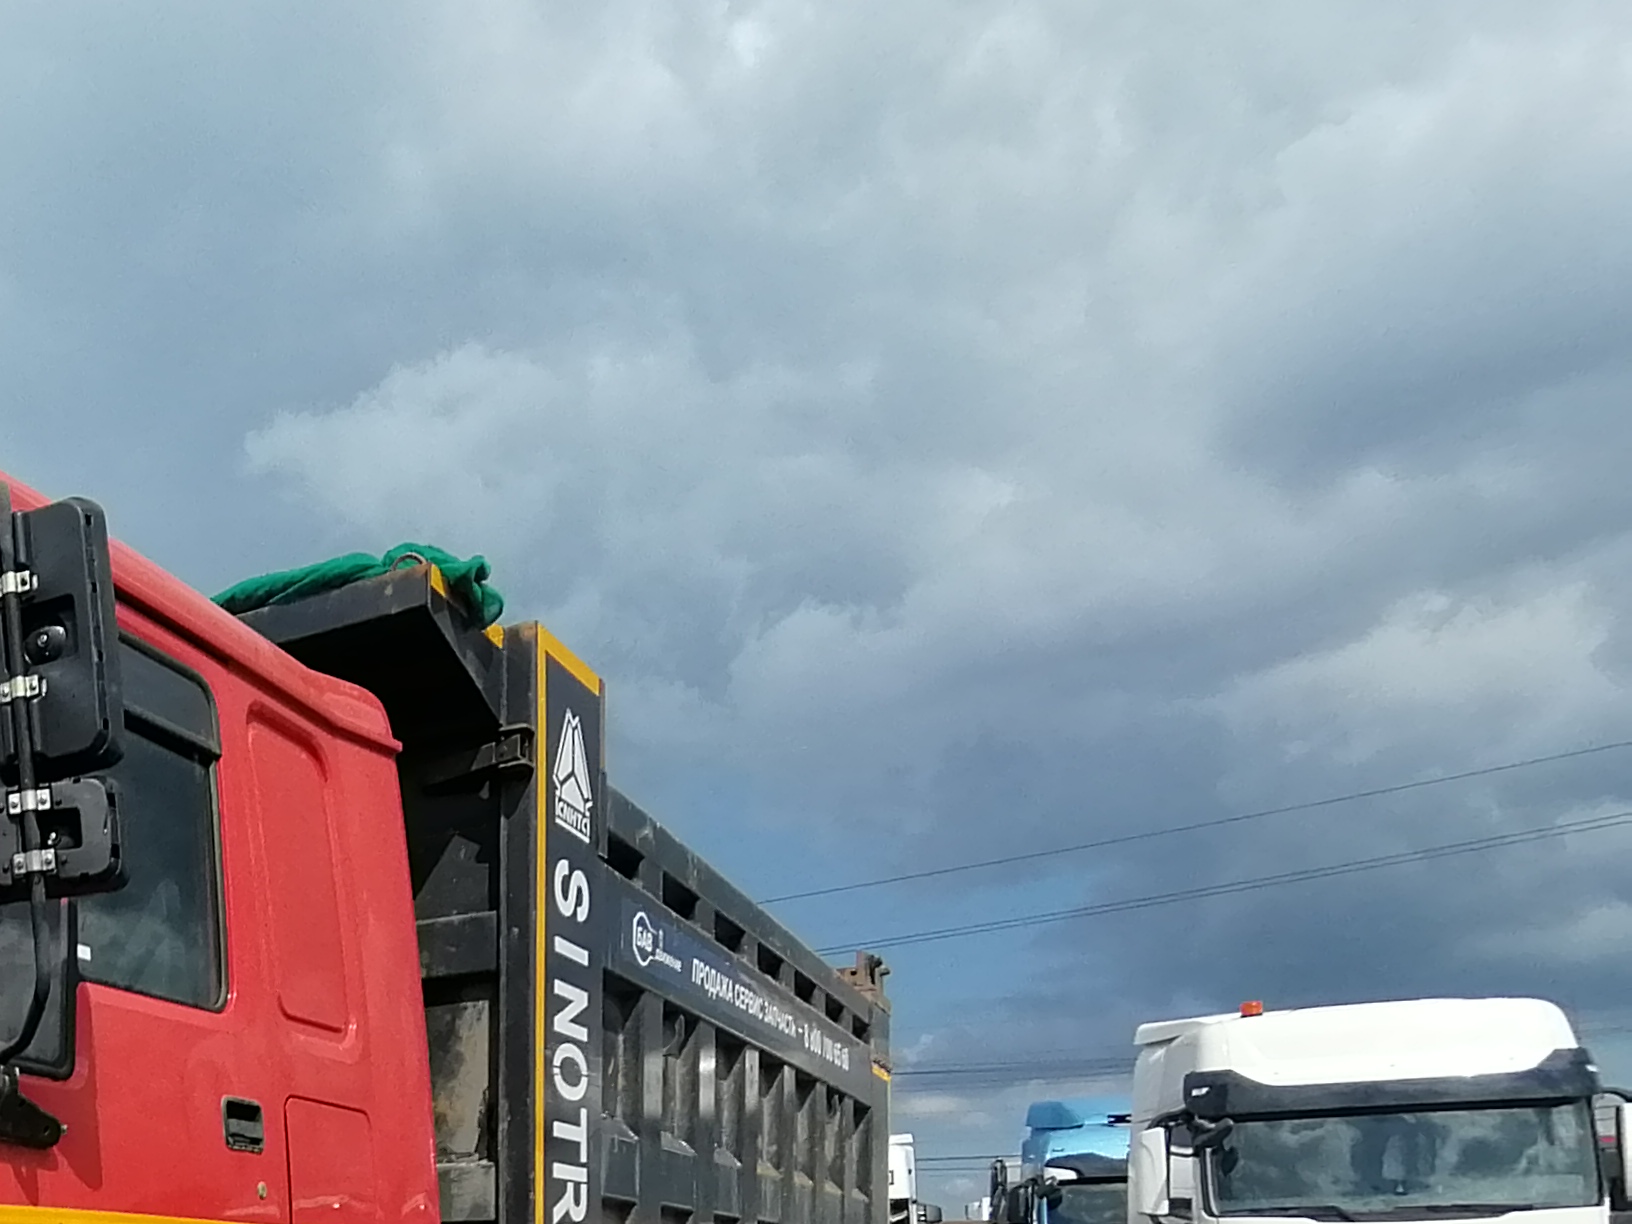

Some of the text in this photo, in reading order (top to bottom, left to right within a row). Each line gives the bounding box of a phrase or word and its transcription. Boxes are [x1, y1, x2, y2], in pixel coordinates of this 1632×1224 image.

[558, 801, 589, 834] CNHTC
[692, 958, 734, 1004] ПРОДАЖА
[734, 983, 764, 1020] СЕРВИС
